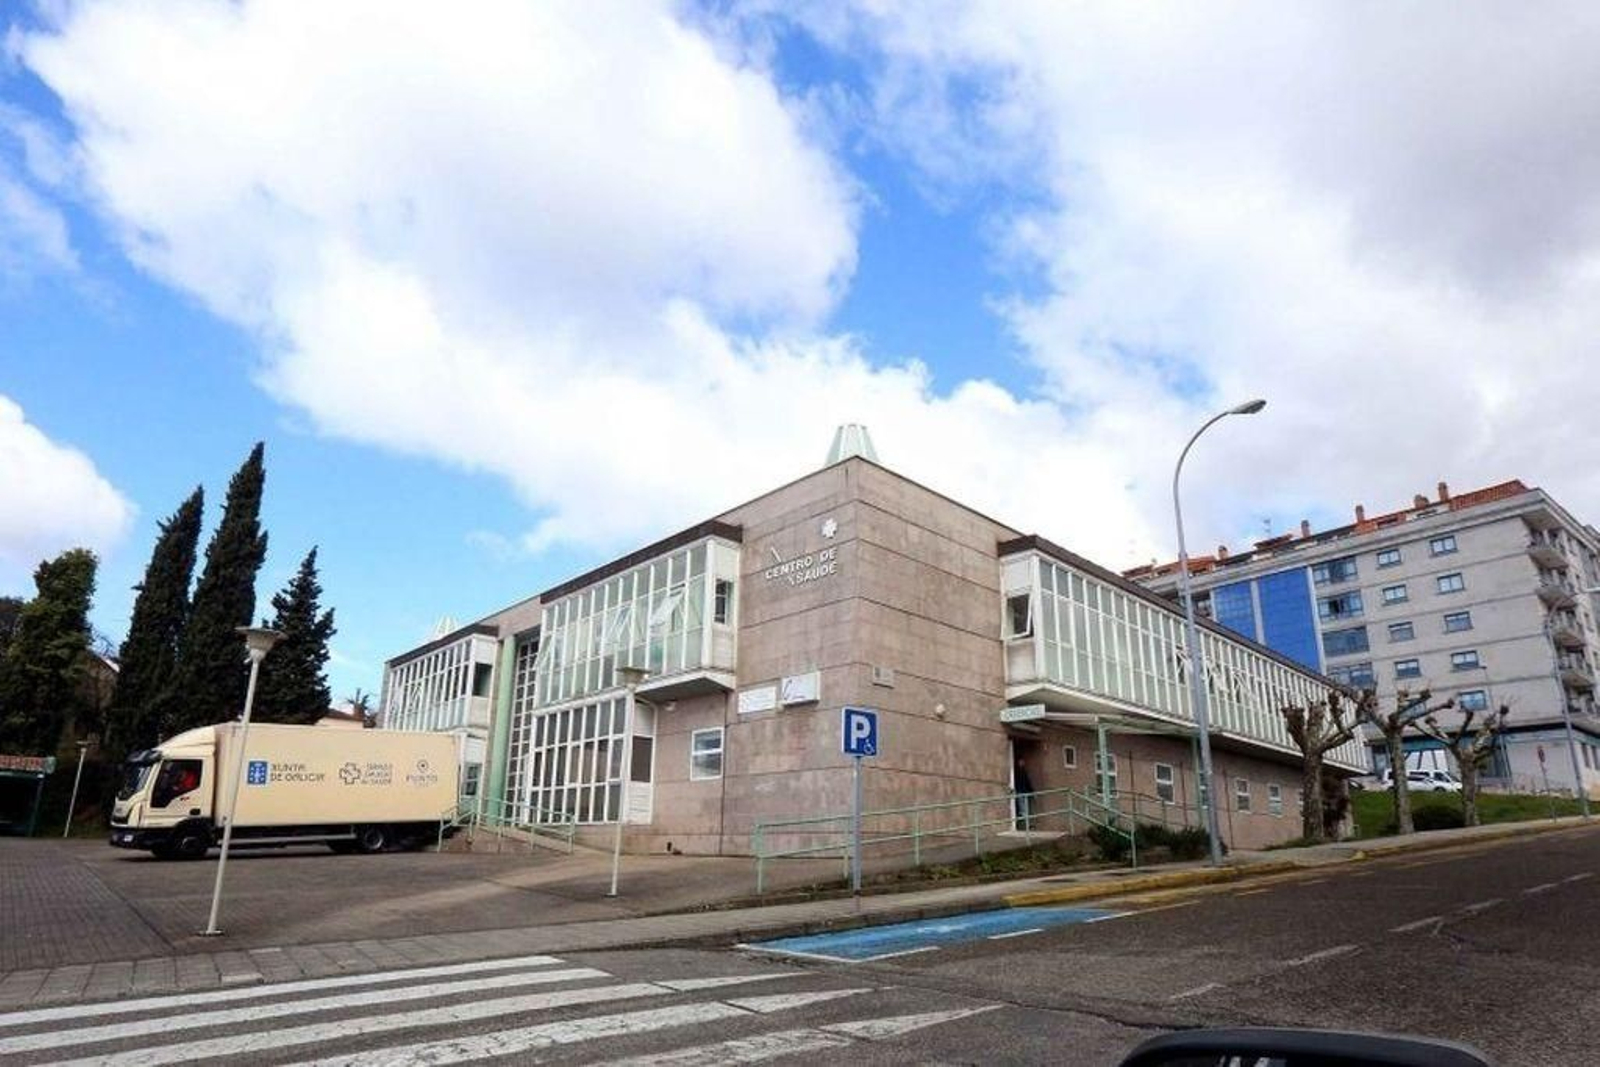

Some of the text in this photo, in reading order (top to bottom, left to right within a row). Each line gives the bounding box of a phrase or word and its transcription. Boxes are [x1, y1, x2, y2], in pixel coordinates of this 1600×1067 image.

[765, 548, 838, 579] CENTRO DE
[850, 713, 871, 749] P
[270, 773, 283, 782] DE
